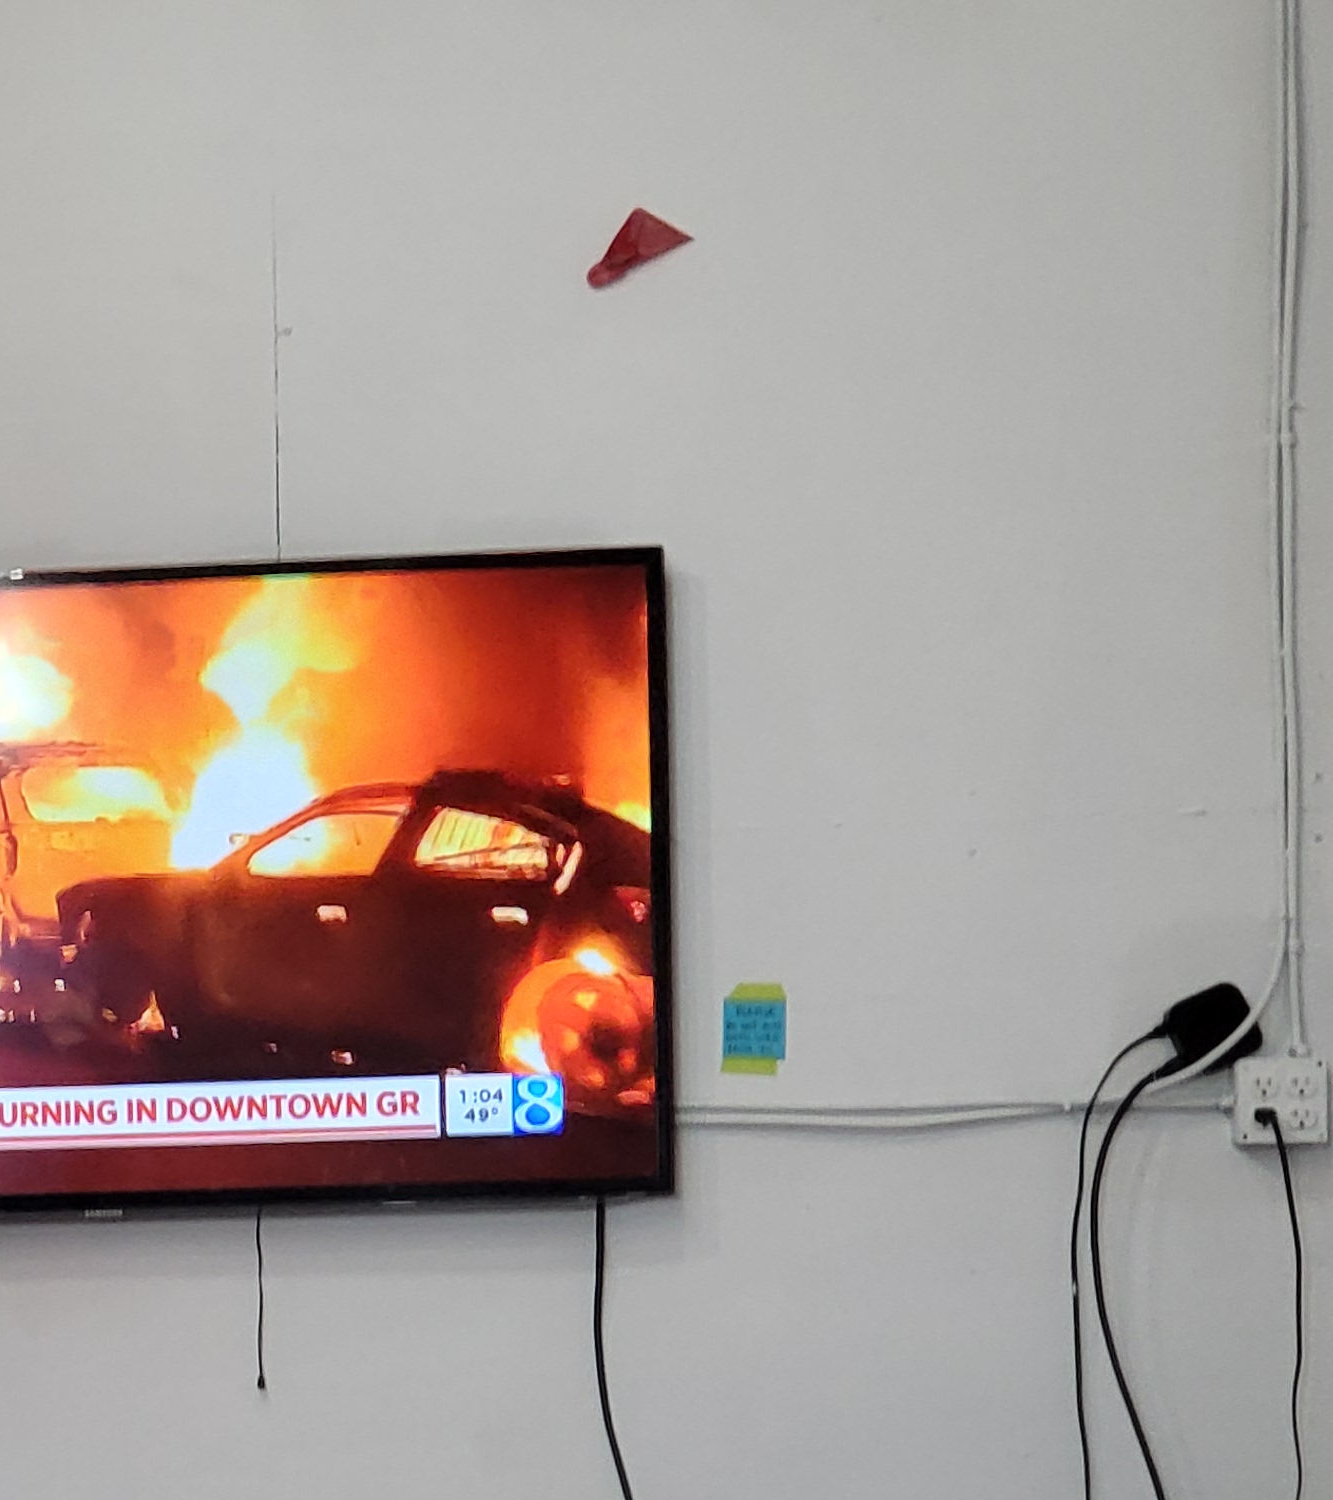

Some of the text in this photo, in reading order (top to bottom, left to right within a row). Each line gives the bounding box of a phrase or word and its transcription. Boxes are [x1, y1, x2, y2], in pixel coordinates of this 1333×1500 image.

[127, 1097, 157, 1124] IN
[166, 1091, 369, 1123] DOWNTOWN
[376, 1090, 421, 1116] GR
[458, 1086, 504, 1105] 1:04
